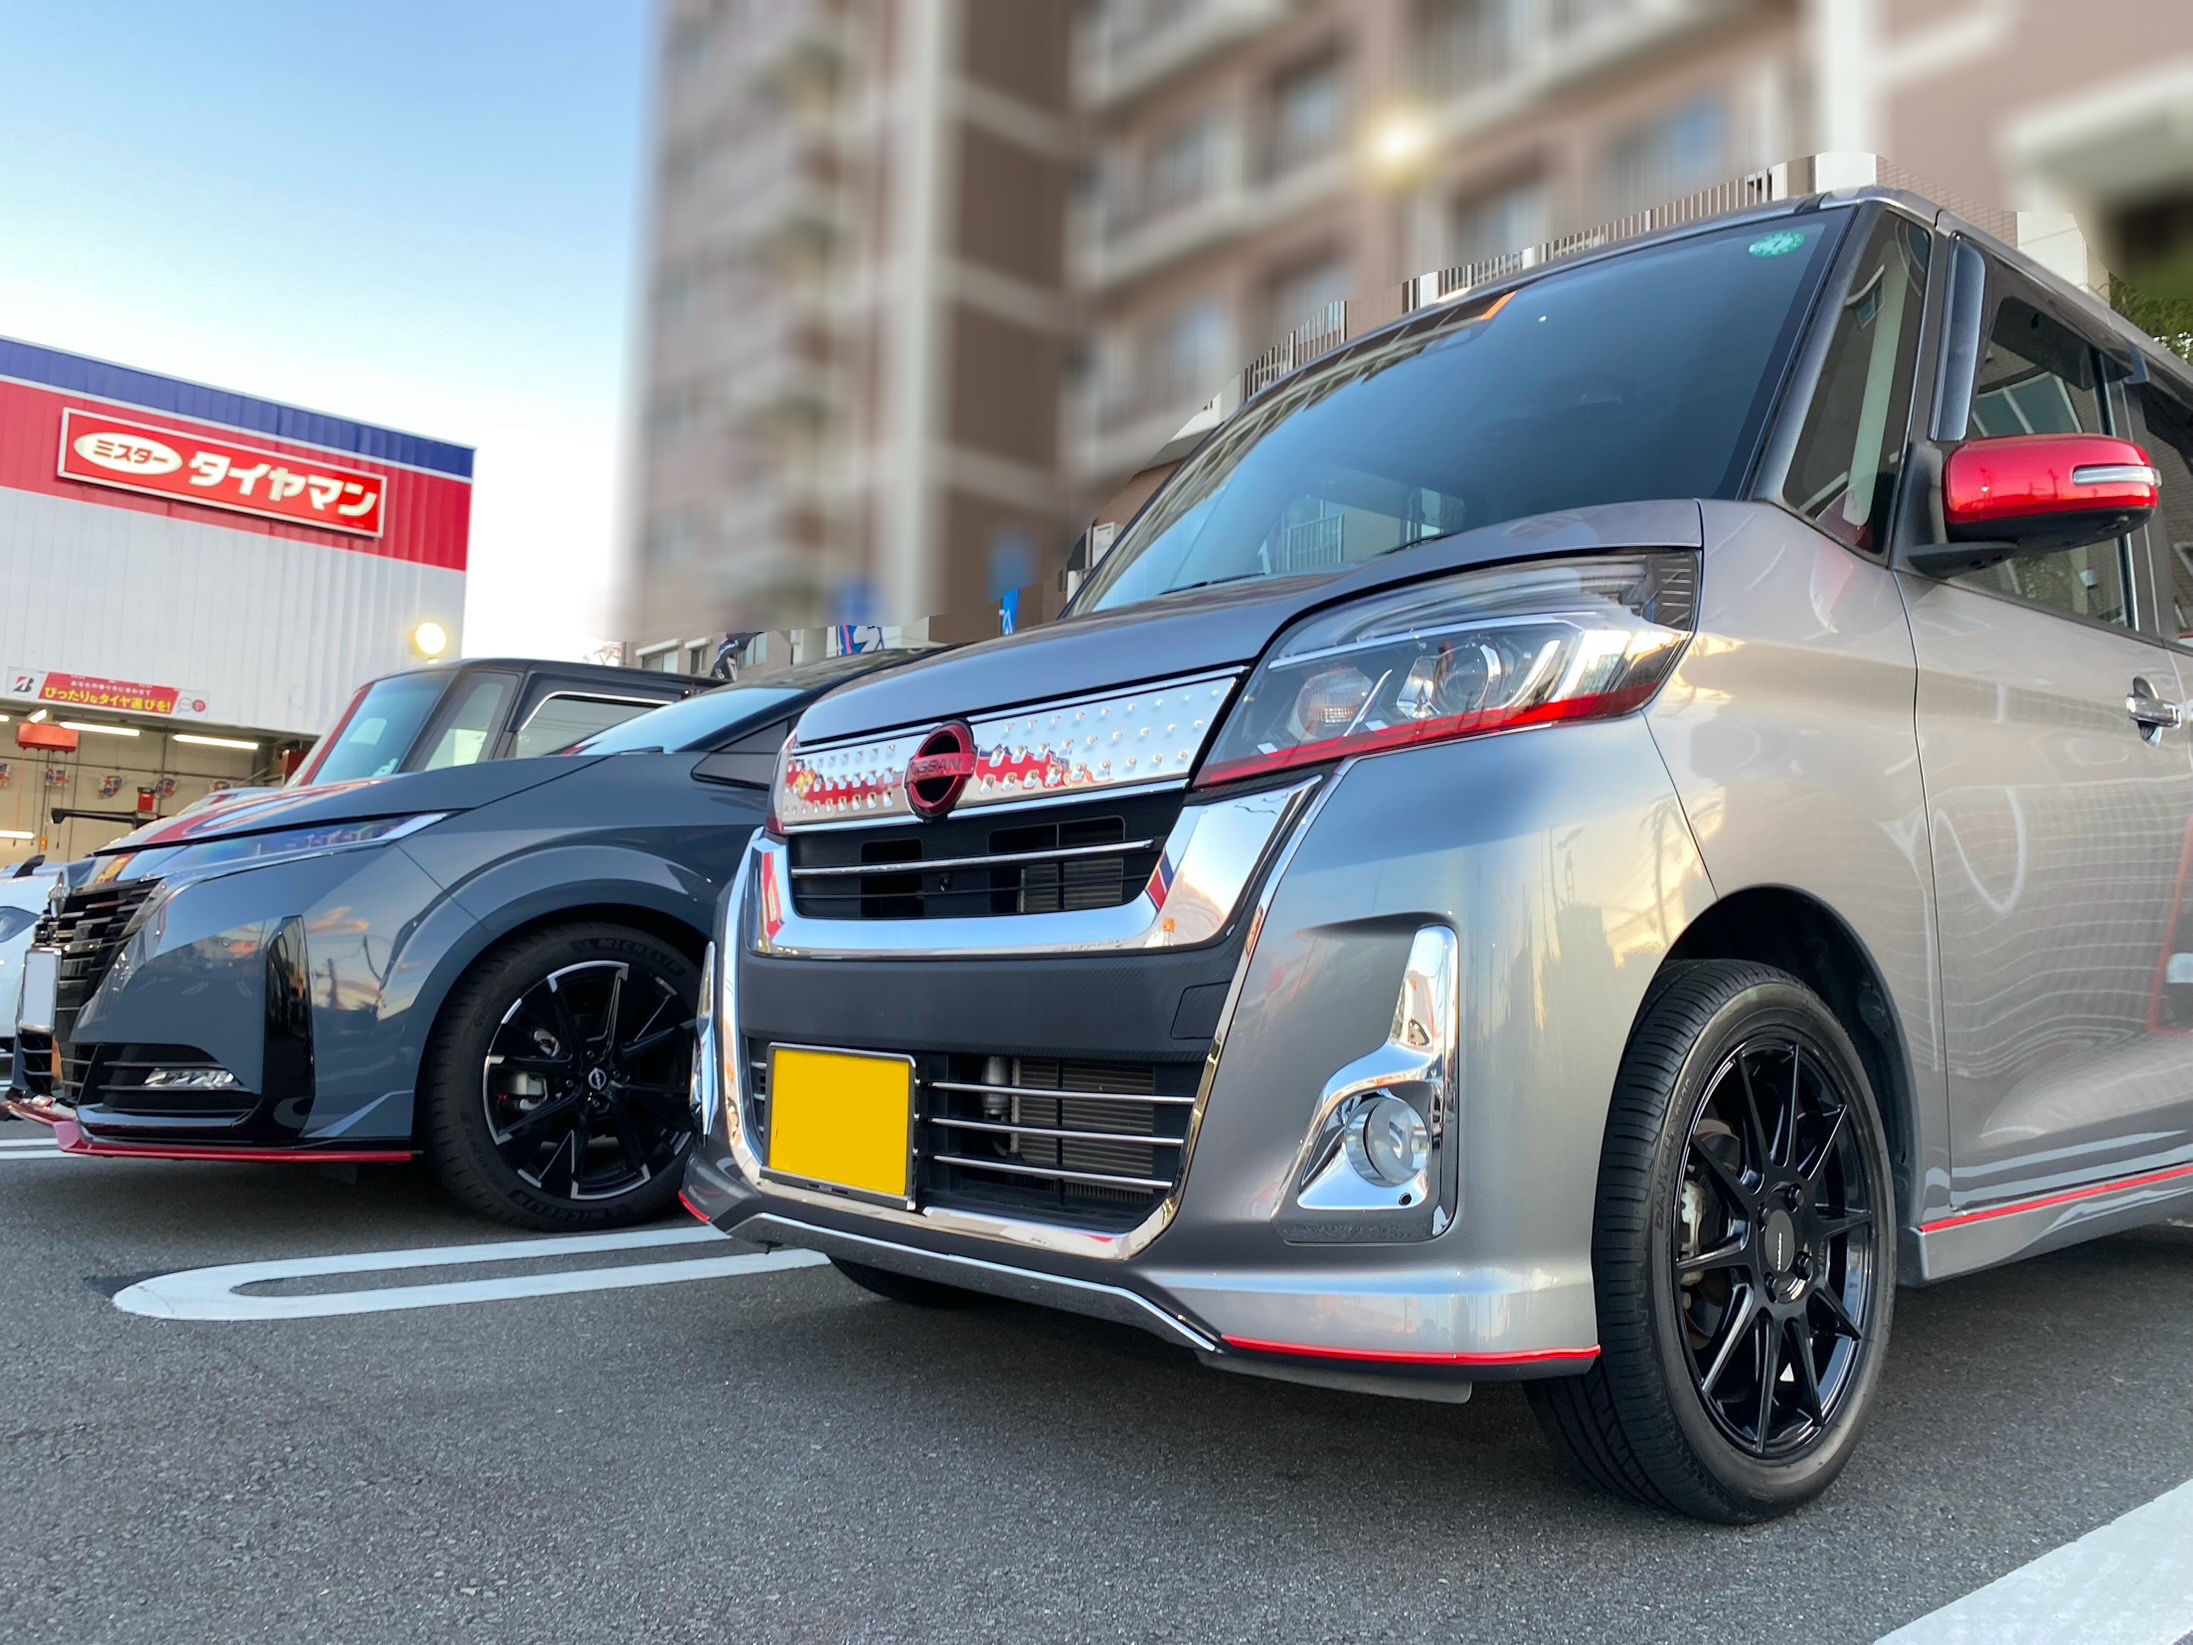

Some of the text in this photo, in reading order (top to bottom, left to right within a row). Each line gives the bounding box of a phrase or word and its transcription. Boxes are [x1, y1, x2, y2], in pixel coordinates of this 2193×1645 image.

[94, 439, 378, 517] ミスター タイヤマン
